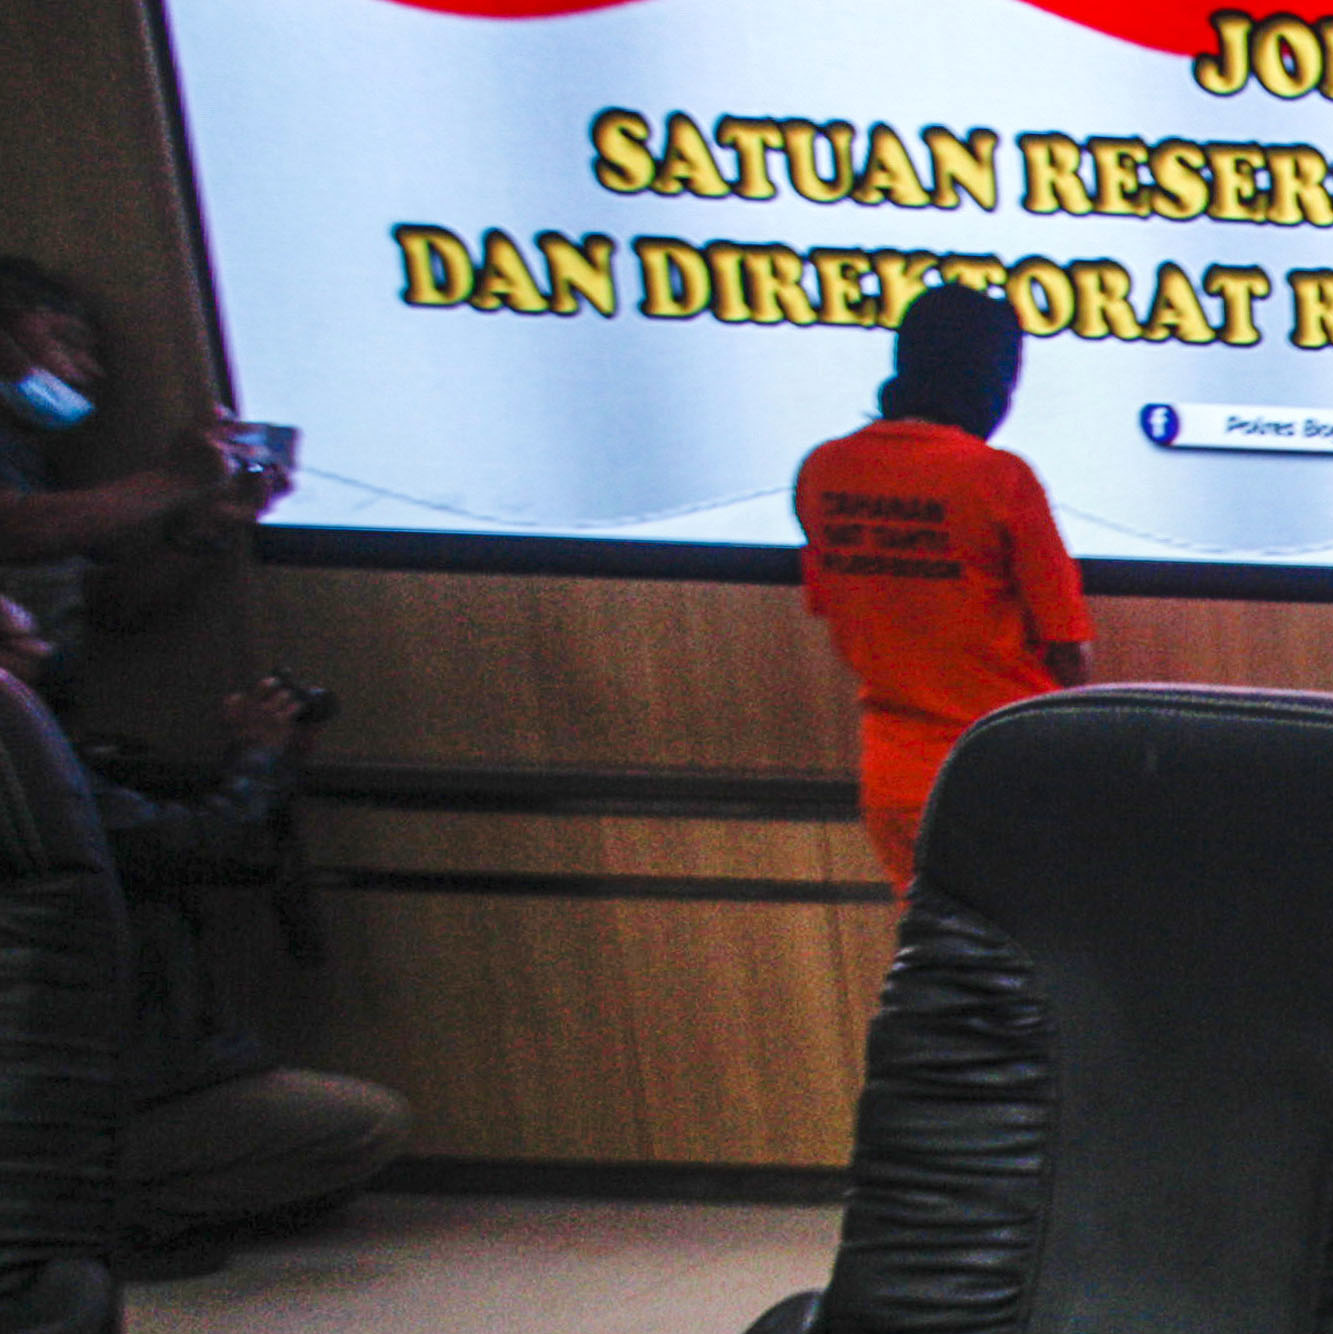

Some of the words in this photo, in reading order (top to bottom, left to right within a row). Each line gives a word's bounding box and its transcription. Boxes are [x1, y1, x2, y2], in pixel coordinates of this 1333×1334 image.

[590, 108, 998, 212] SATUAN
[392, 222, 619, 318] DAN
[1225, 415, 1294, 436] Polres
